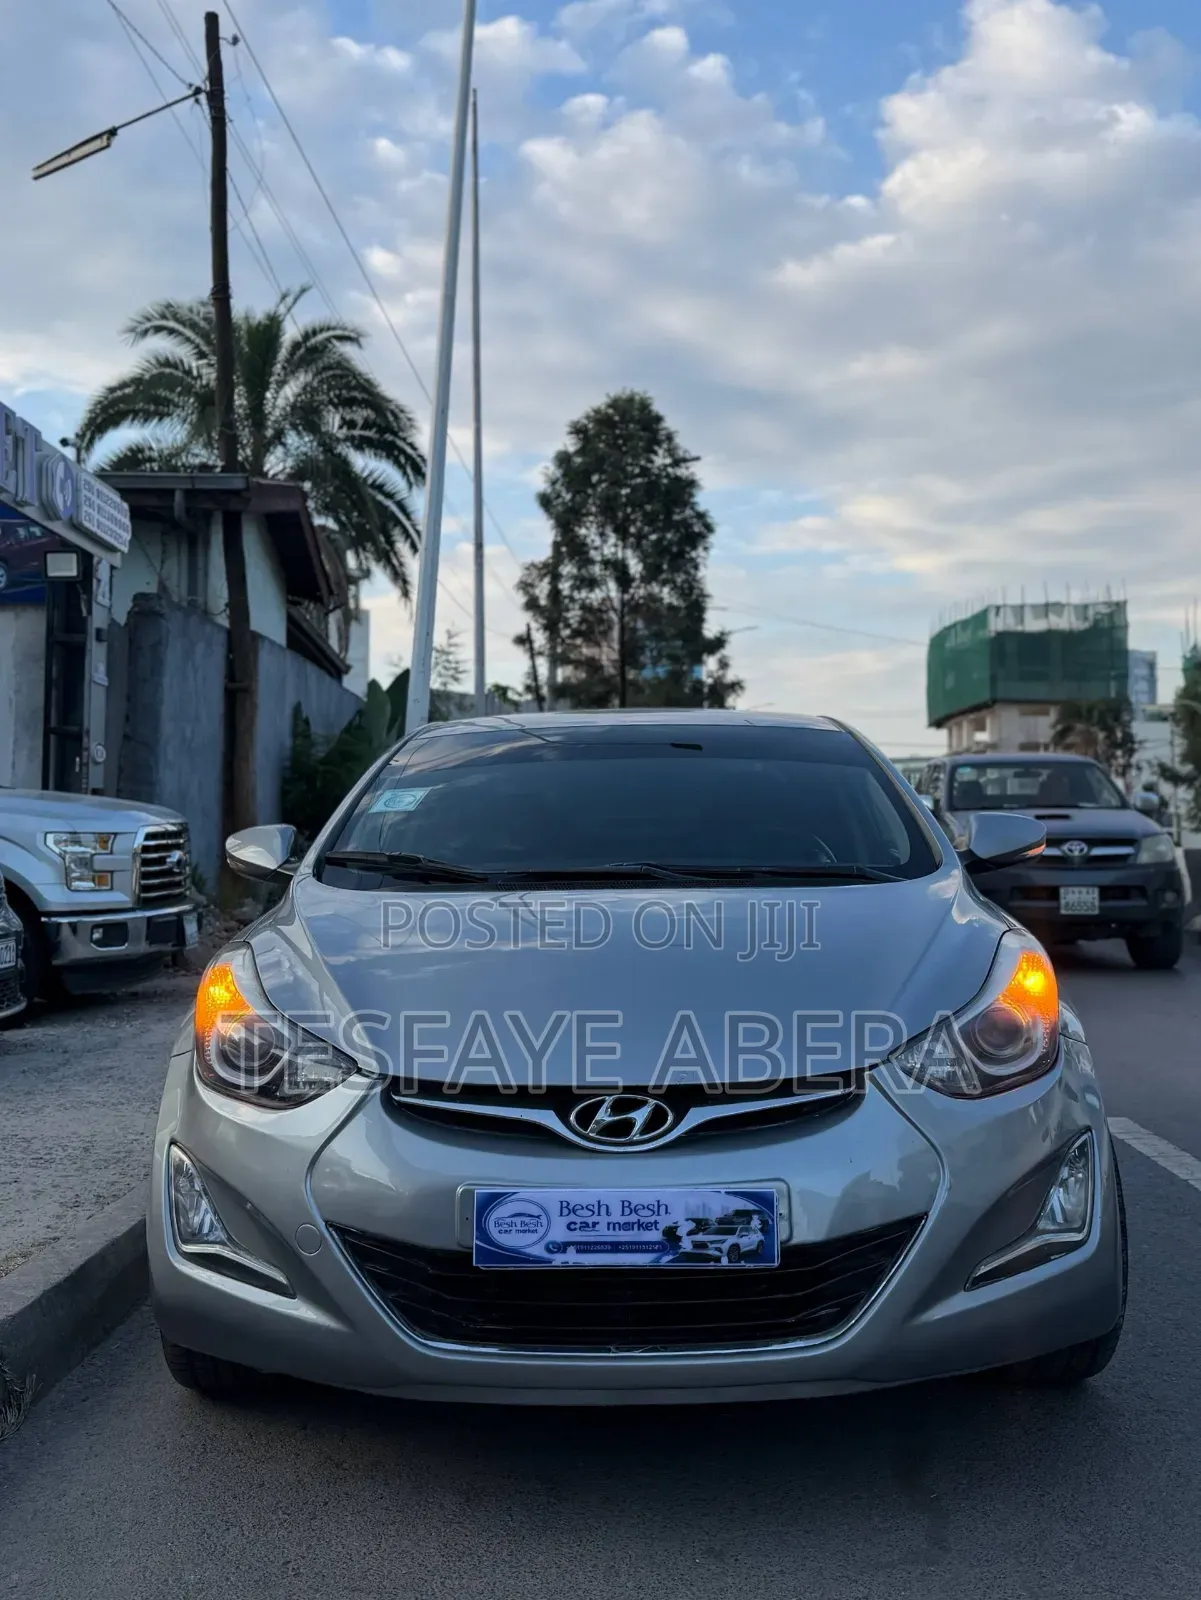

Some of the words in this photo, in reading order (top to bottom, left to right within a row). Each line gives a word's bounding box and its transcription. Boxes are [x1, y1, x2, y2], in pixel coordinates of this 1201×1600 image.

[558, 1200, 612, 1218] Besh
[620, 1200, 671, 1218] Besh
[493, 1220, 517, 1229] Besh
[520, 1220, 543, 1228] Besh
[566, 1220, 600, 1232] car
[607, 1219, 660, 1232] market
